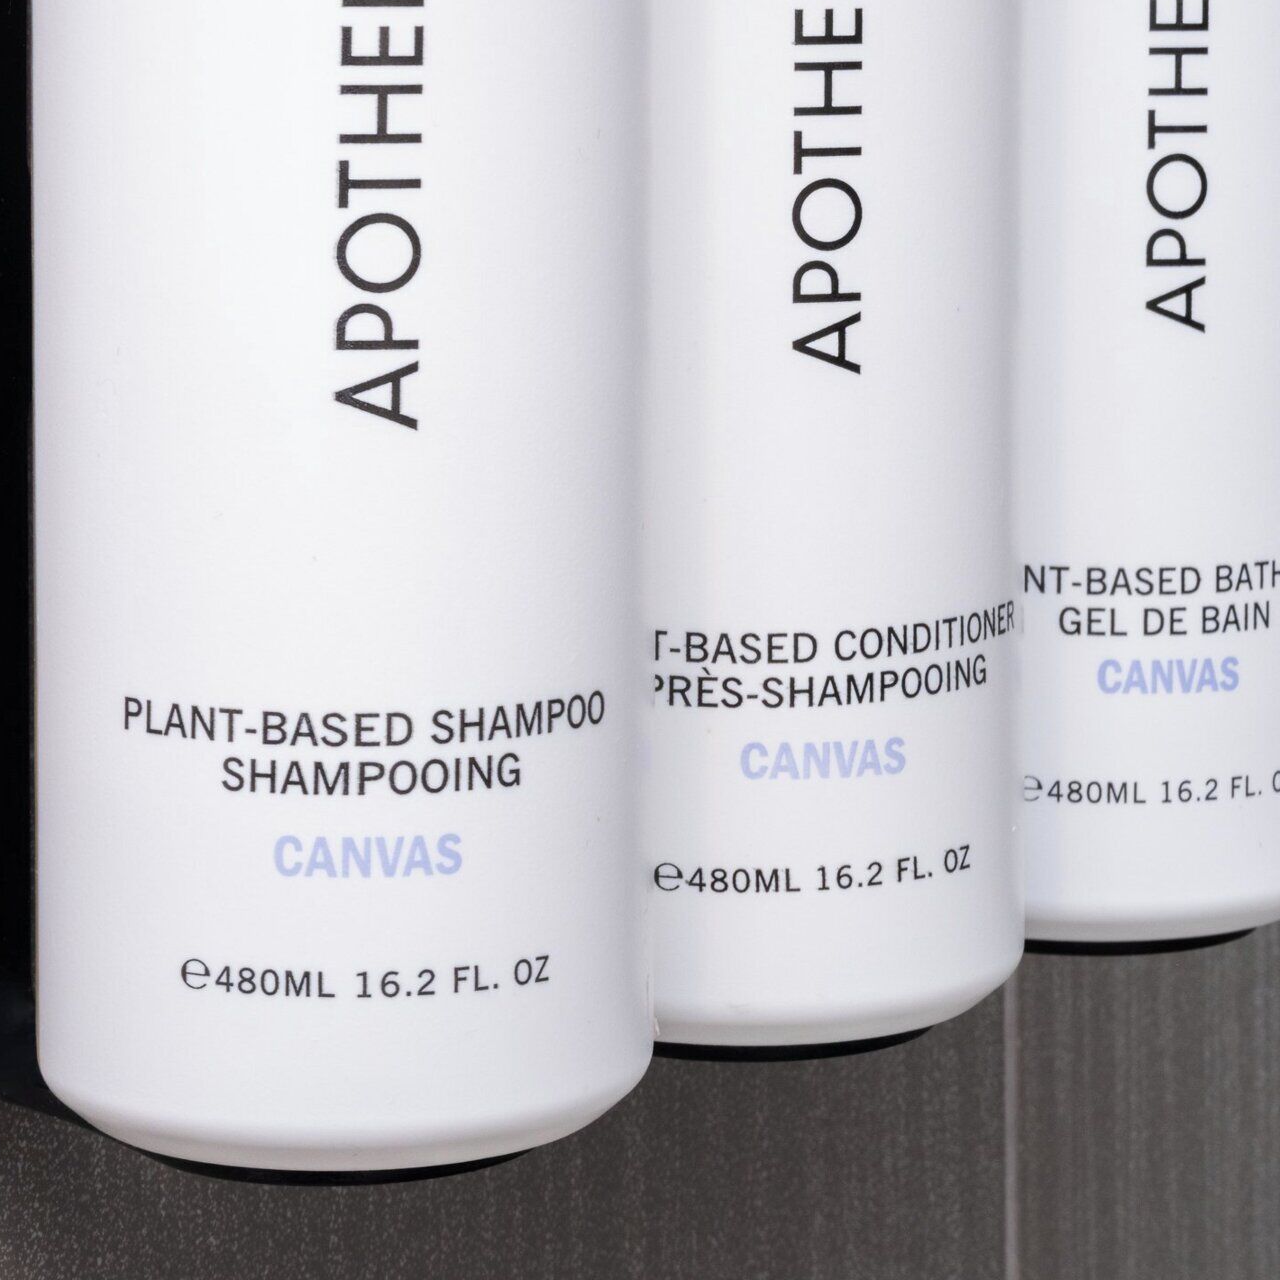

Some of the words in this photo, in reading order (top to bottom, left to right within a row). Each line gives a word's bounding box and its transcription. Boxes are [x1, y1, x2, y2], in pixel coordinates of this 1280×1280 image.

[1023, 563, 1202, 596] NT-BASED
[833, 599, 1015, 662] CONDITIONER
[1058, 605, 1129, 638] GEL
[1142, 605, 1188, 638] DE
[1200, 599, 1271, 636] BAIN
[1097, 656, 1240, 695] CANVAS
[123, 695, 415, 749] PLANT-BASED
[429, 689, 606, 746] SHAMPOO
[220, 751, 522, 797] SHAMPOOING
[740, 737, 906, 780] CANVAS
[1160, 777, 1219, 805] 16.2
[1230, 774, 1263, 800] FL.
[274, 833, 463, 878] CANVAS
[815, 859, 884, 892] 16.2
[895, 855, 934, 884] FL.
[942, 843, 971, 875] OZ
[355, 967, 437, 1000] 16.2
[452, 964, 500, 995] FL.
[512, 953, 550, 987] OZ
